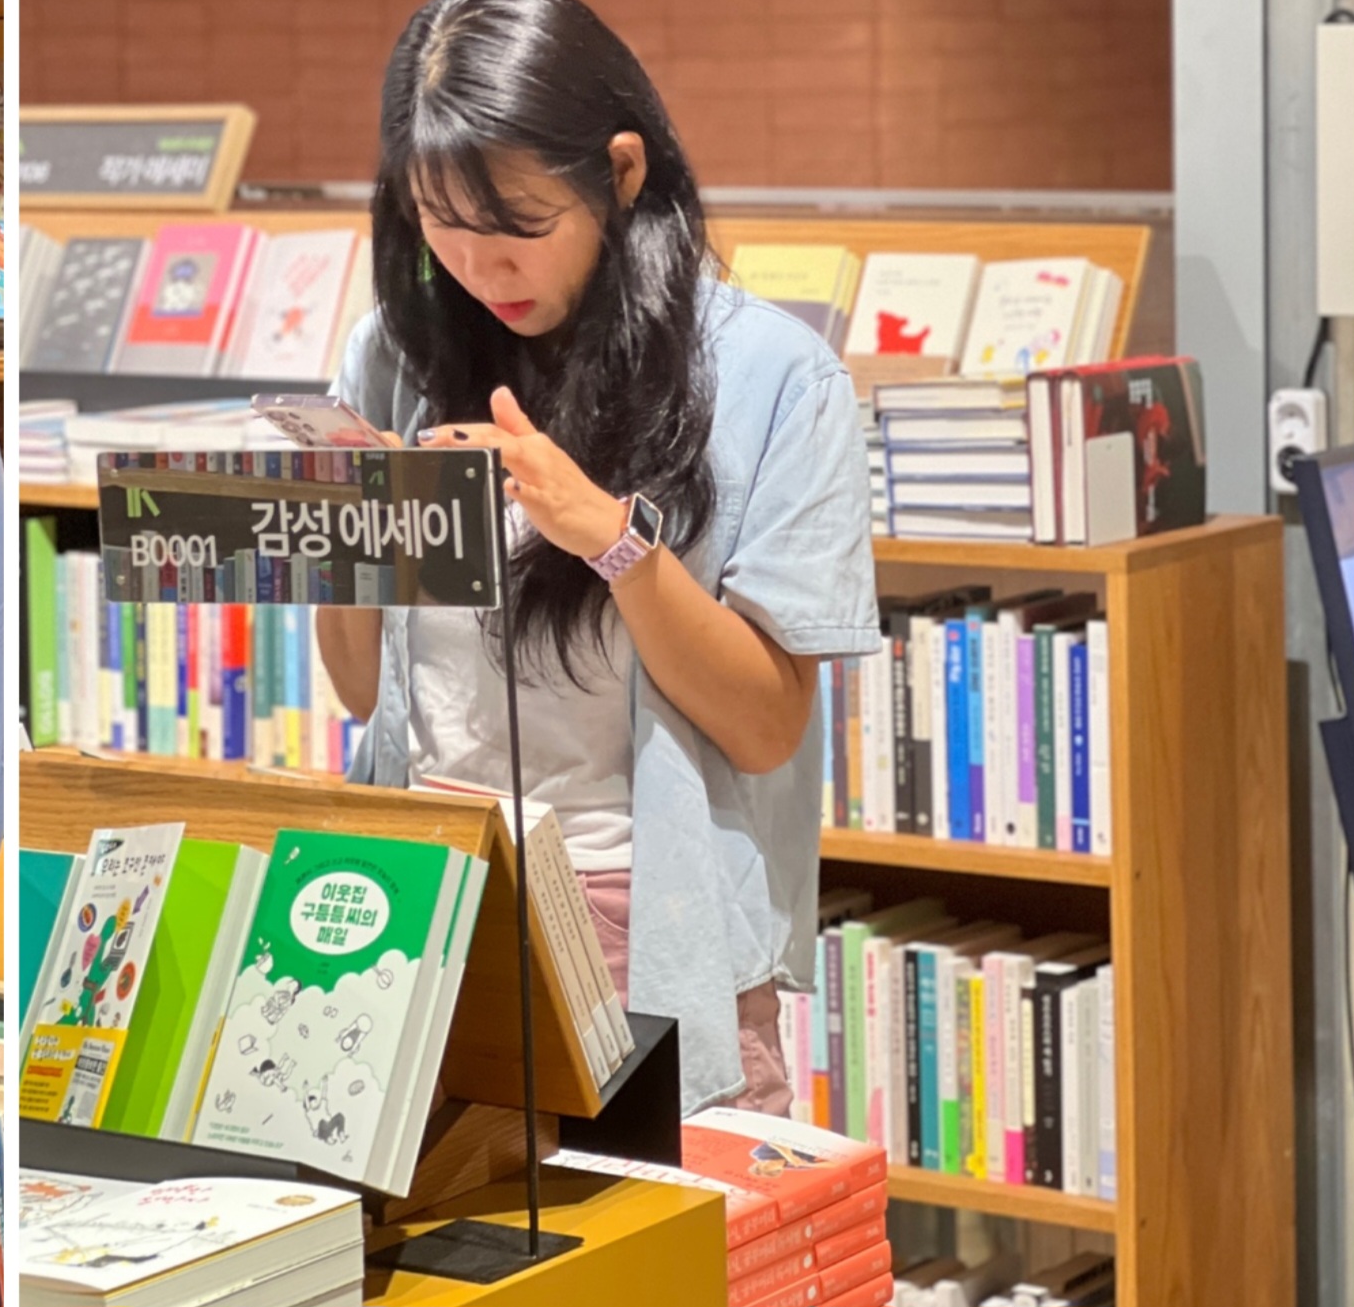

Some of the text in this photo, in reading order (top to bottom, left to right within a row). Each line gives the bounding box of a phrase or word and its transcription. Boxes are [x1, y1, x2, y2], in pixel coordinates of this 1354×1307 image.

[250, 498, 465, 560] 감성 에세이
[131, 533, 219, 568] B0001
[321, 882, 367, 905] 이웃집
[316, 926, 349, 946] 매일
